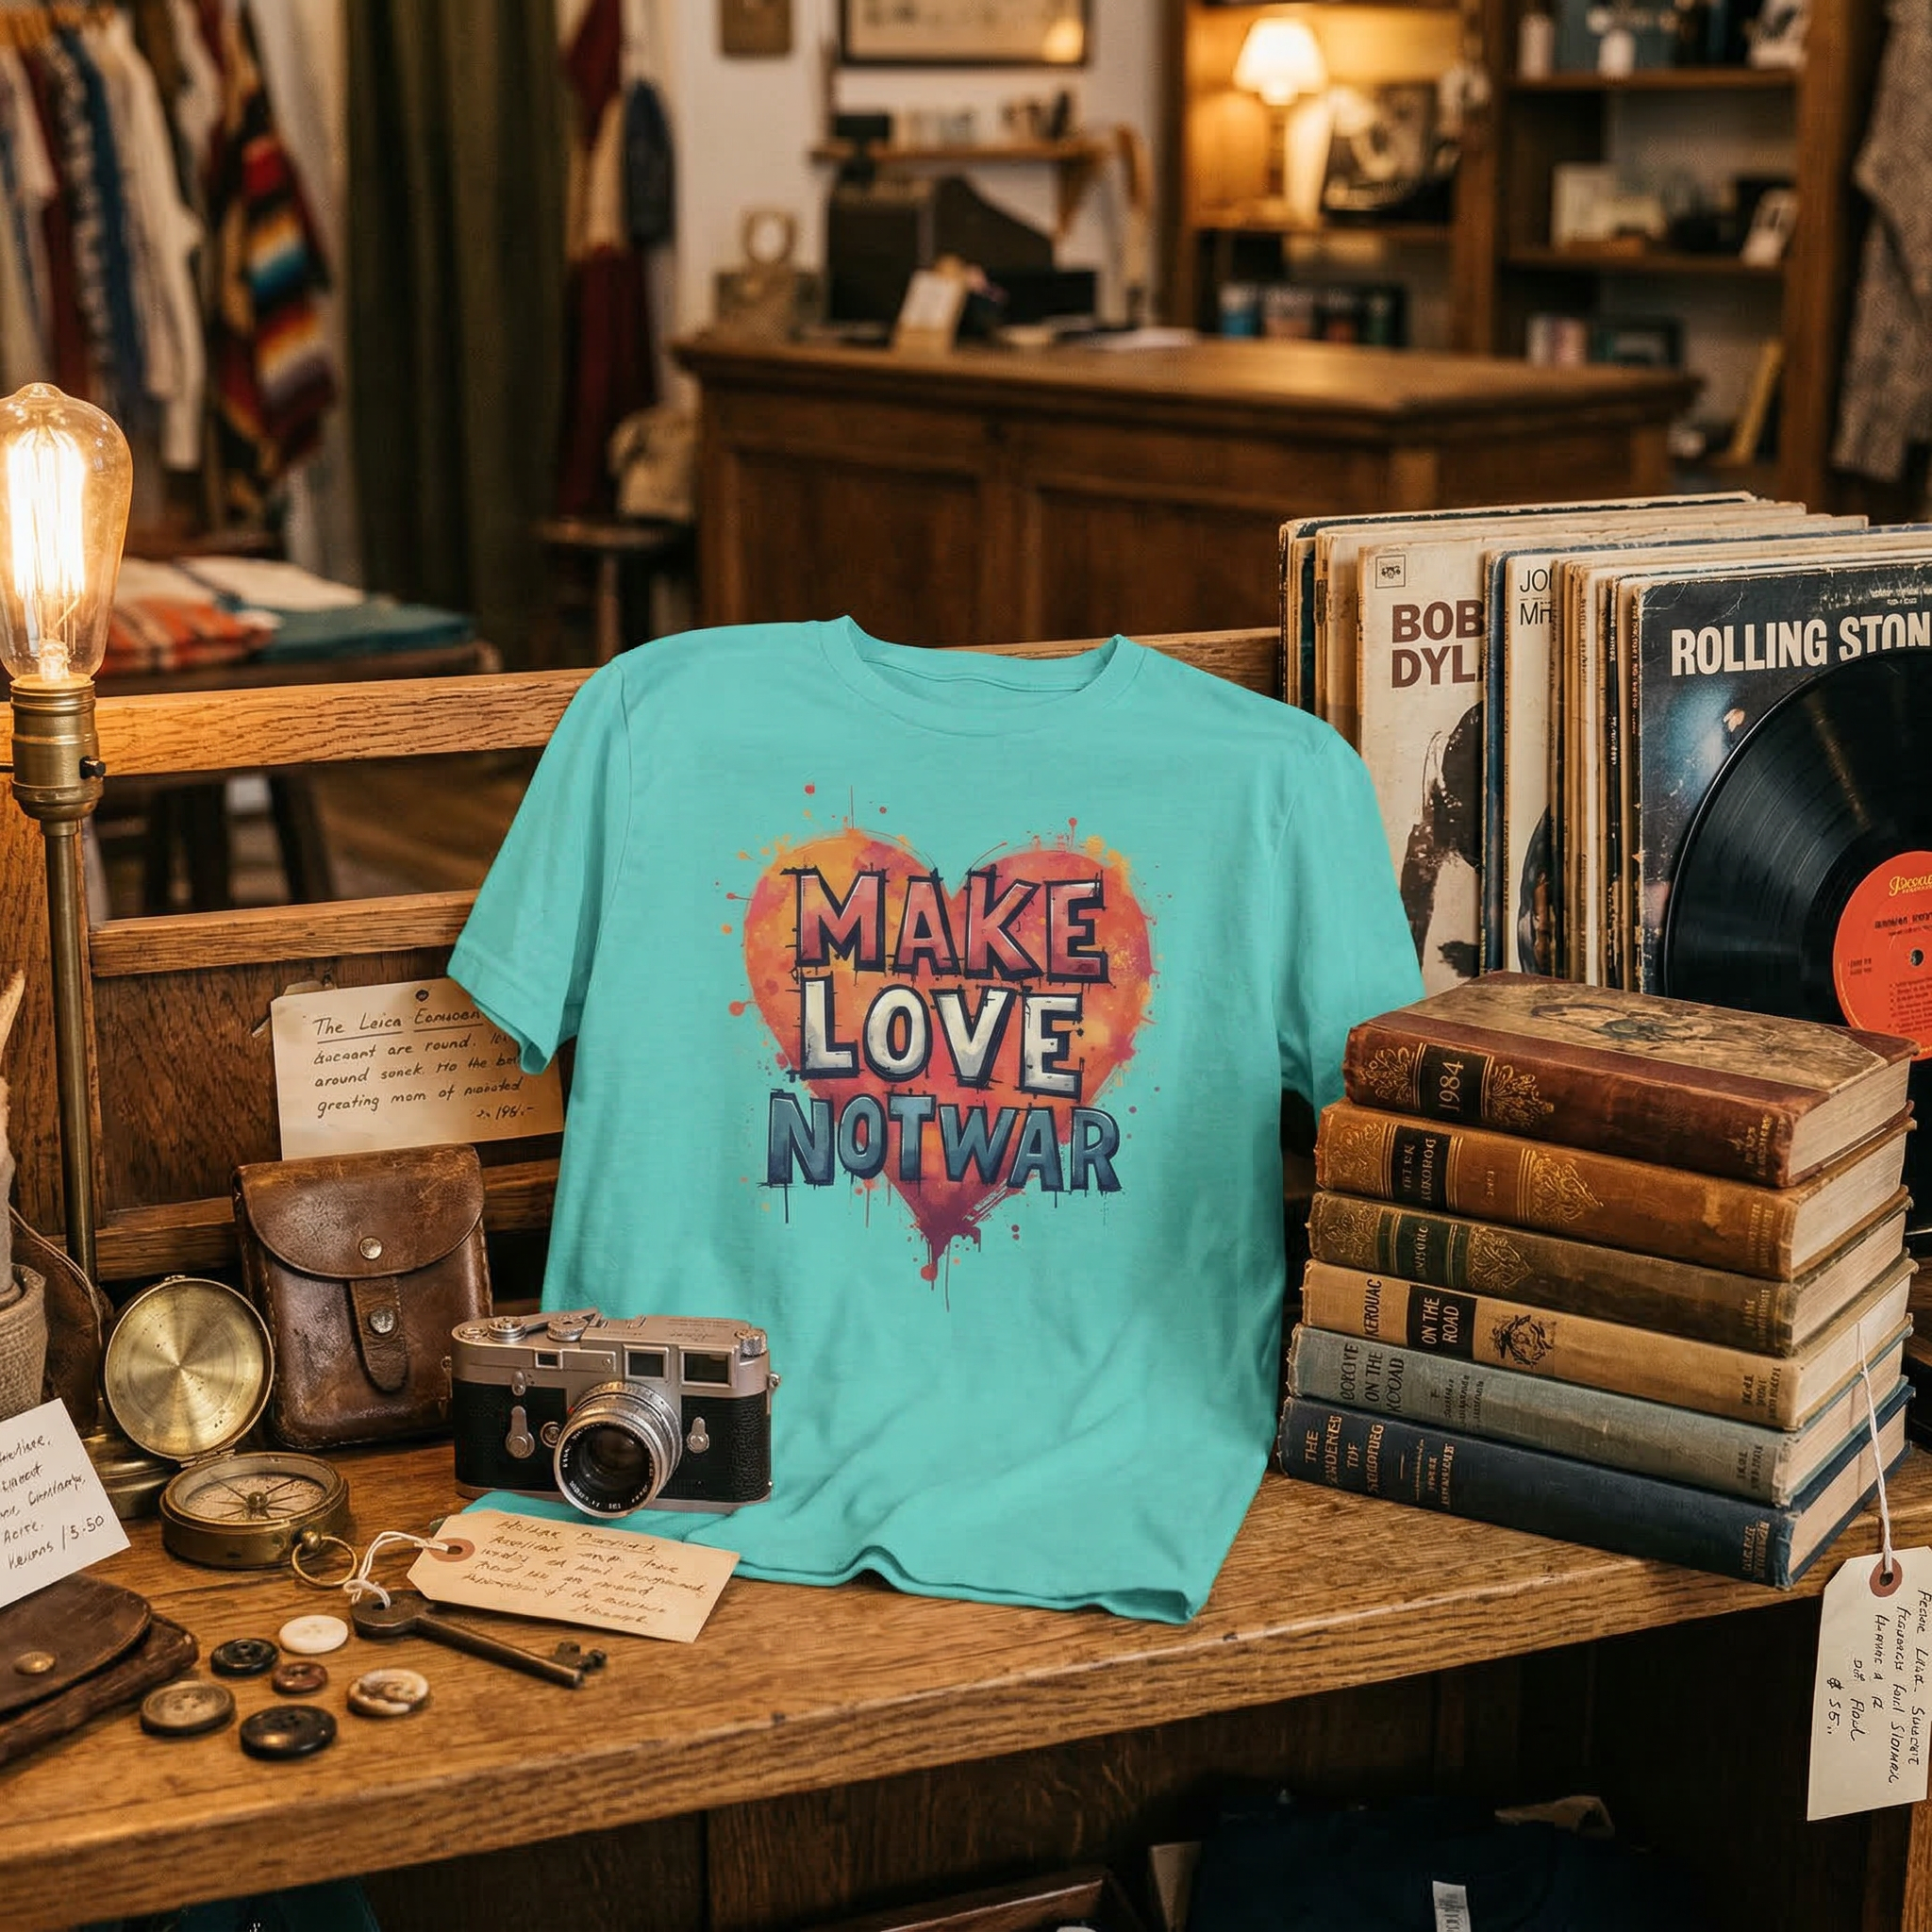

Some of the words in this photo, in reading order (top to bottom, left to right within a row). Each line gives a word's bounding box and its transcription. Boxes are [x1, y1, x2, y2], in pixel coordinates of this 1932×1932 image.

[1391, 599, 1484, 643] BOB
[1671, 618, 1828, 676] ROLLING
[1391, 644, 1484, 689] DYL
[787, 865, 1111, 983] MAKE
[312, 1017, 345, 1036] The
[359, 1012, 402, 1030] Leica
[799, 974, 1084, 1099] LOVE
[388, 1045, 413, 1057] are
[314, 1066, 371, 1088] around
[1438, 1060, 1465, 1114] 1984
[317, 1094, 379, 1120] greating
[391, 1092, 427, 1104] mom
[439, 1084, 456, 1102] of
[1363, 1277, 1383, 1339] KEROUAC
[1422, 1296, 1441, 1322] THE
[1441, 1305, 1460, 1344] ROAD
[1421, 1324, 1439, 1345] ON
[1364, 1351, 1384, 1377] THE
[1364, 1381, 1381, 1403] ON
[1304, 1429, 1320, 1464] THE
